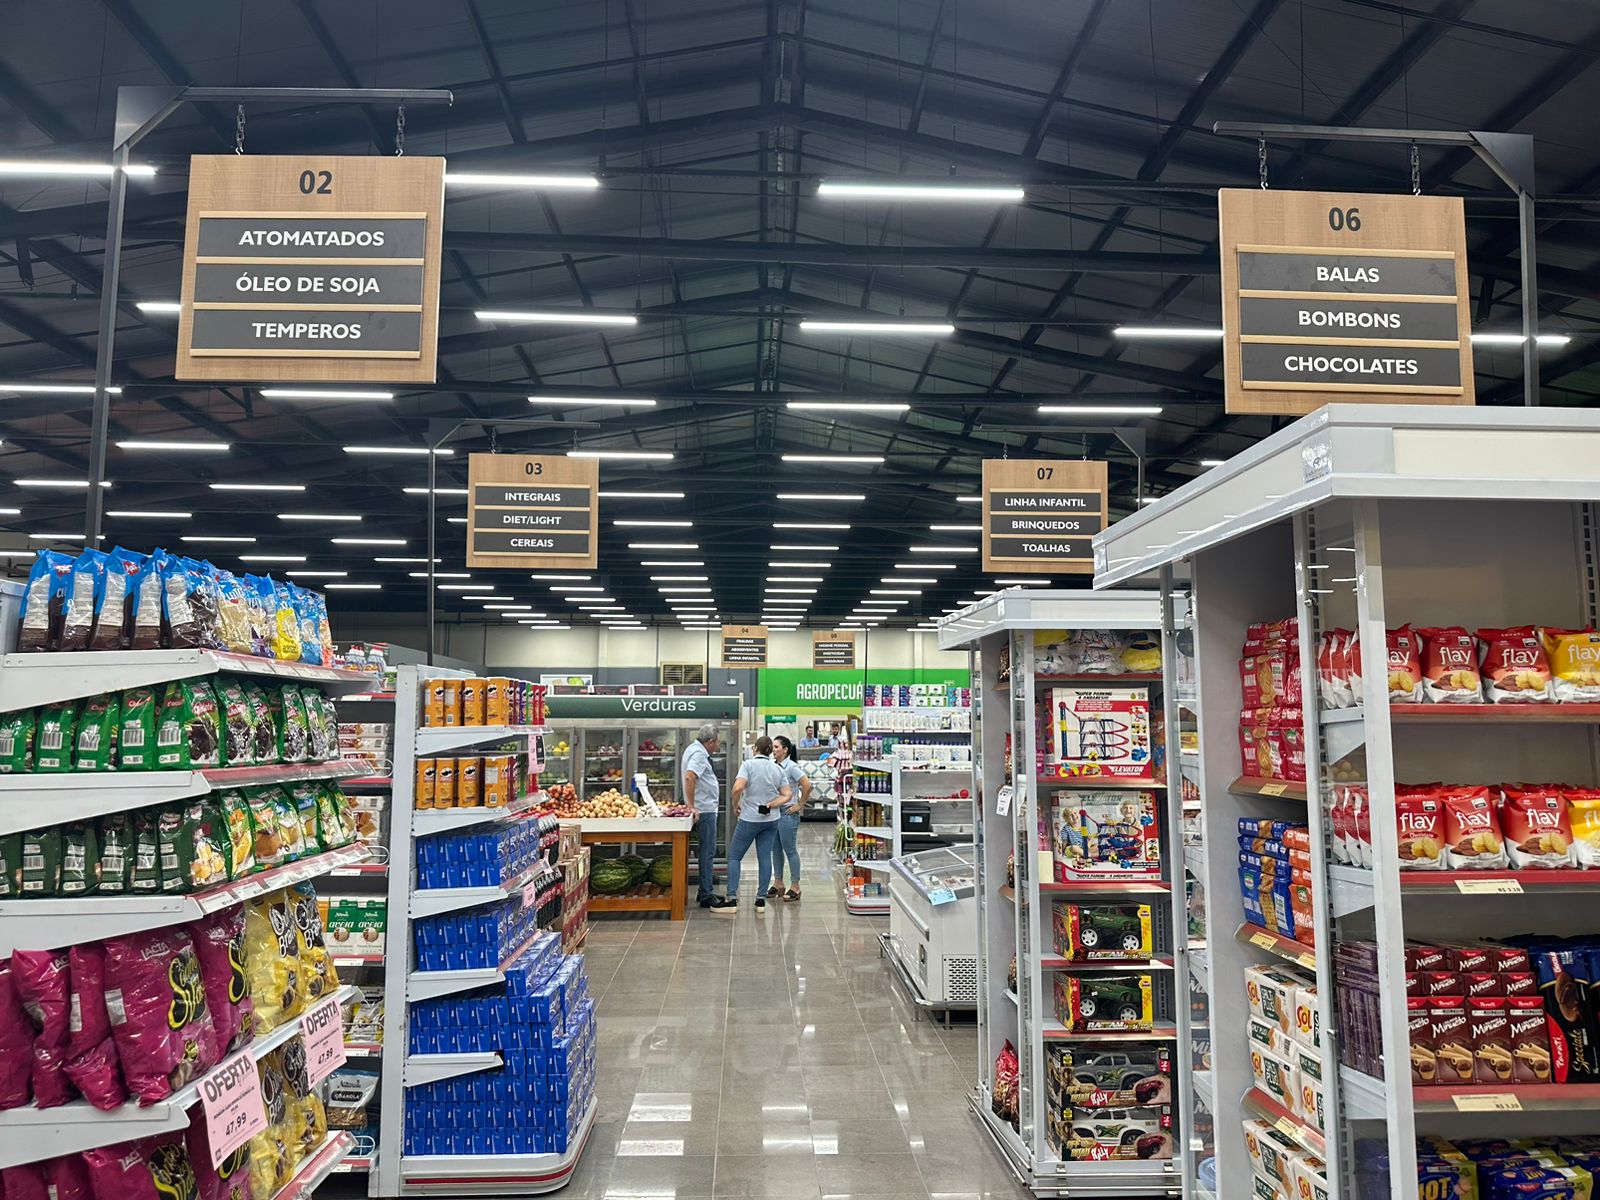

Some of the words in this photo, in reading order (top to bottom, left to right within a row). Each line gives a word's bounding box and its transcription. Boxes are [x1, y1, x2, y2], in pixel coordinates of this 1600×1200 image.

[300, 170, 333, 195] 02
[1329, 207, 1361, 231] 06
[238, 230, 385, 247] ATOMATADOS
[1316, 266, 1380, 283] BALAS
[235, 272, 291, 292] ÓLEO
[297, 277, 324, 292] DE
[330, 277, 380, 296] SOJA
[1298, 310, 1401, 328] BOMBONS
[252, 322, 362, 339] TEMPEROS
[1284, 356, 1418, 375] CHOCOLATES
[525, 462, 543, 475] 03
[1037, 467, 1054, 480] 07
[504, 492, 561, 502] INTEGRAIS
[1004, 498, 1037, 507] LINHA
[1039, 498, 1086, 507] INFANTIL
[503, 515, 561, 525] DIET/LIGHT
[1011, 520, 1080, 531] BRINQUEDOS
[510, 538, 554, 548] CEREAIS
[1022, 543, 1071, 553] TOALHAS
[1386, 649, 1410, 665] lay
[1439, 644, 1472, 664] flay
[1501, 648, 1539, 667] flay
[621, 698, 697, 712] Verduras
[1400, 812, 1437, 832] flay
[1456, 810, 1491, 829] flay
[1526, 808, 1560, 828] flay
[1584, 810, 1600, 828] fl
[328, 920, 355, 929] aveia
[358, 920, 384, 929] aveia
[142, 941, 170, 960] LACTA
[306, 1000, 338, 1036] OFERTA
[1407, 1017, 1429, 1031] inueto
[1431, 1016, 1467, 1038] Minueto
[1472, 1017, 1507, 1039] Minueto
[1510, 1017, 1545, 1038] Minueto
[1553, 1035, 1563, 1069] Parati
[1569, 1027, 1591, 1075] Speciale
[204, 1055, 254, 1102] OFERTA
[225, 1112, 247, 1136] 47,99
